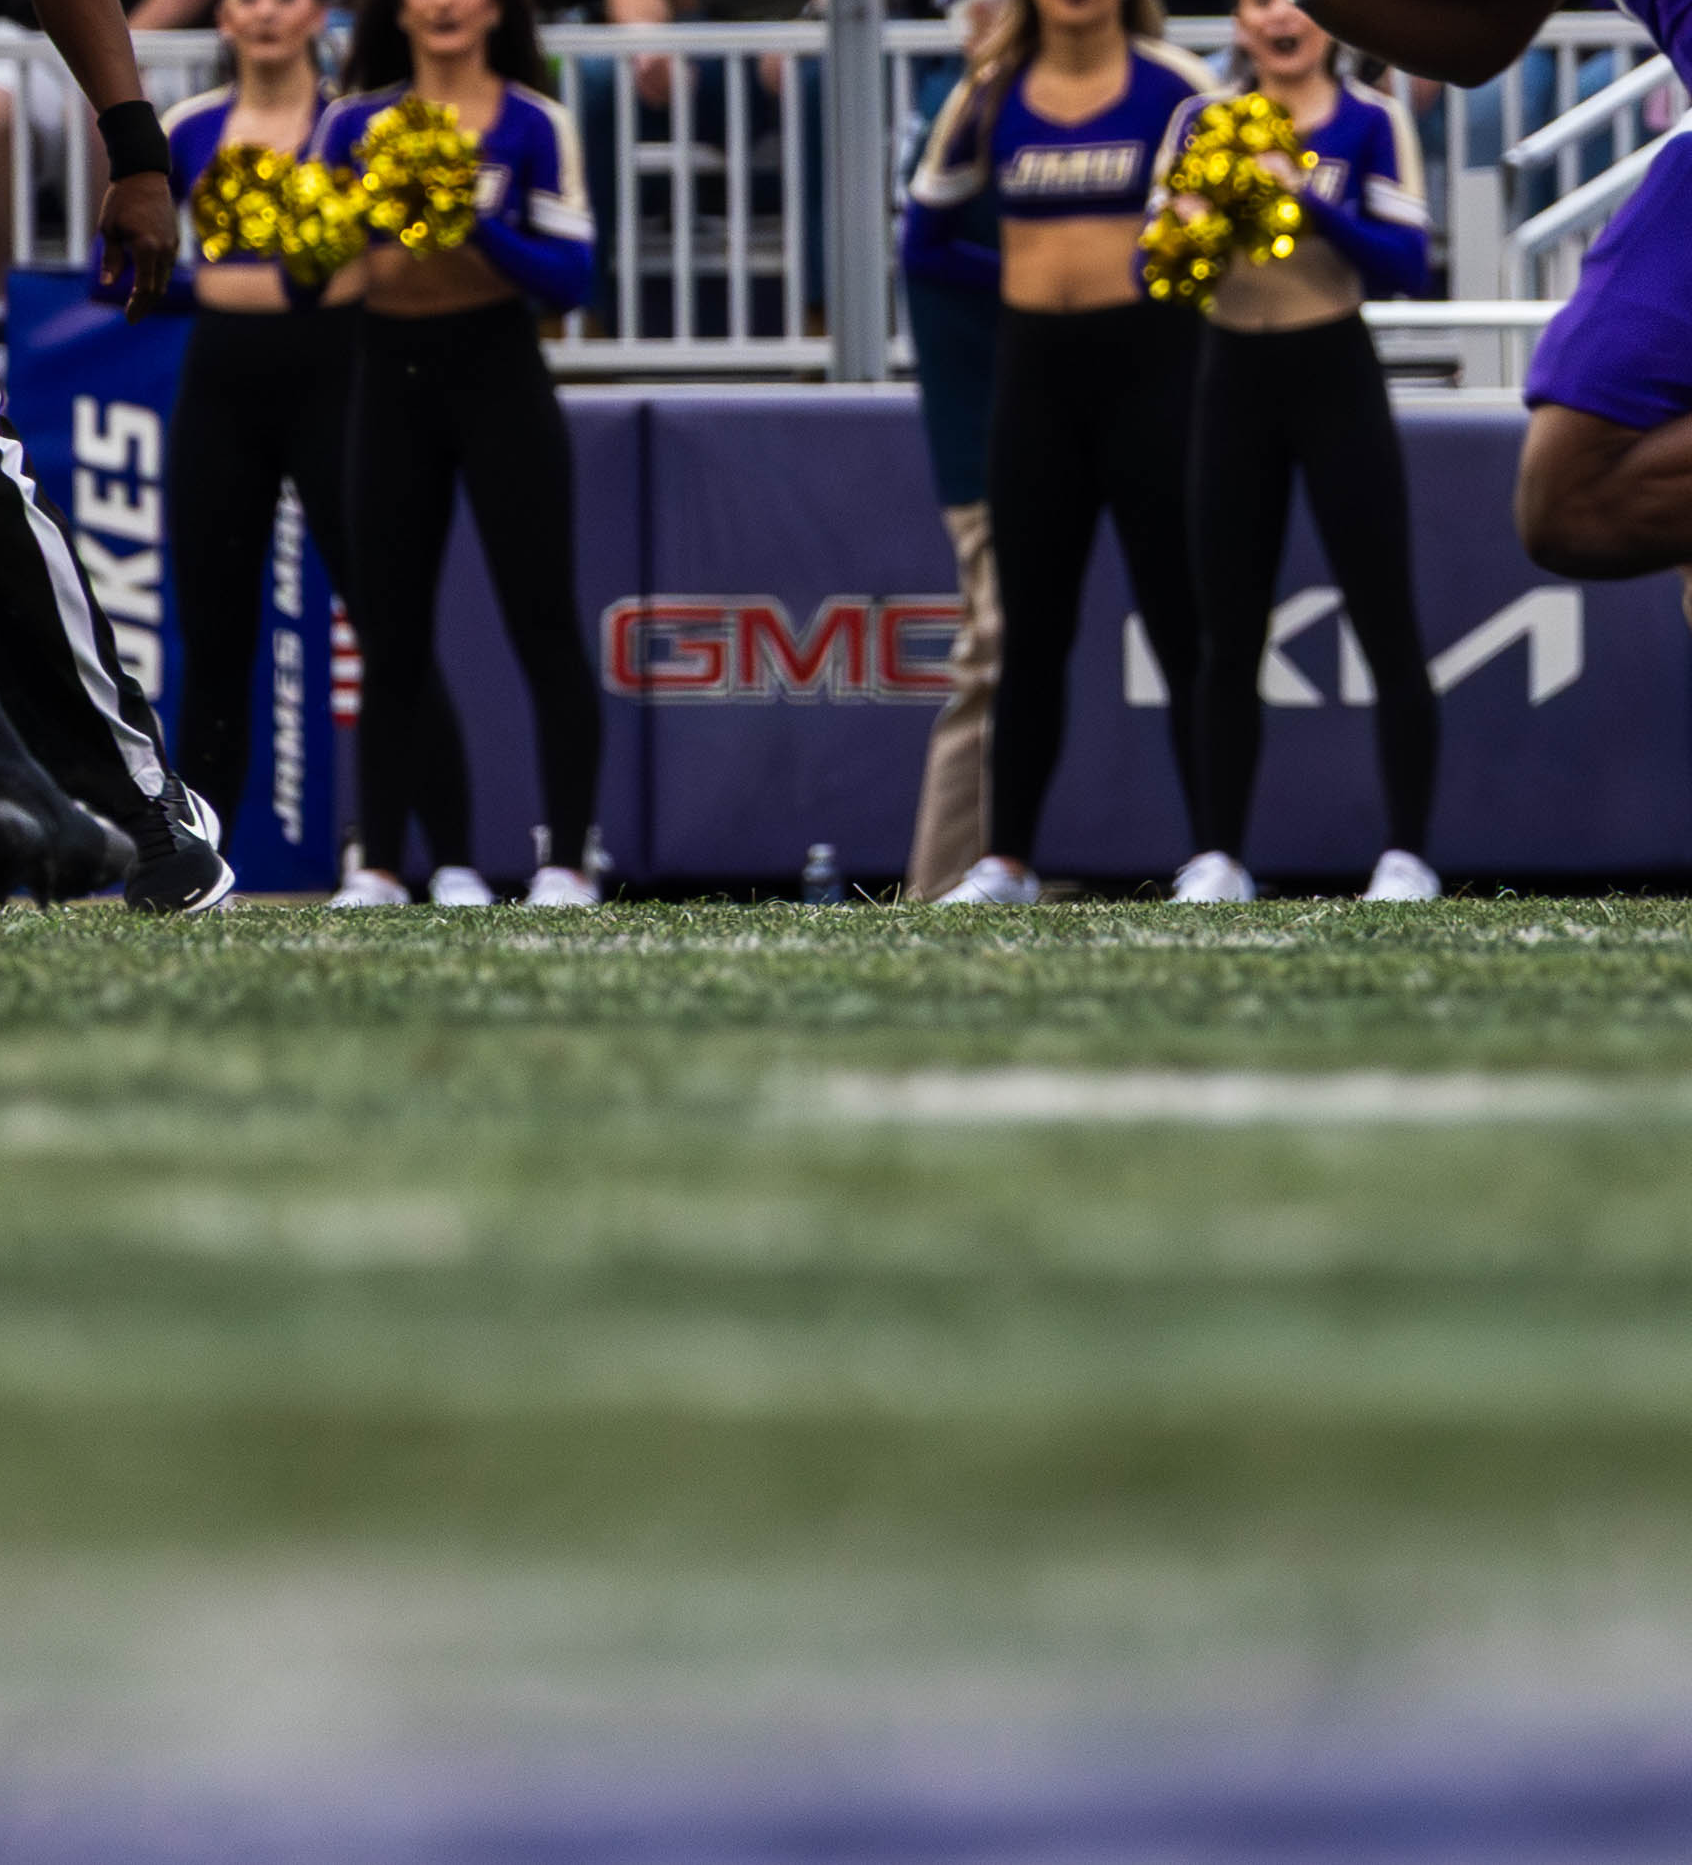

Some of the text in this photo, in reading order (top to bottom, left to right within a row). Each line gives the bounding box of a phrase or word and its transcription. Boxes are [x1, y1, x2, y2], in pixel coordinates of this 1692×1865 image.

[1001, 141, 1146, 198] JMU
[73, 392, 164, 739] UKES
[601, 594, 968, 706] GMC
[273, 628, 306, 846] JAMES
